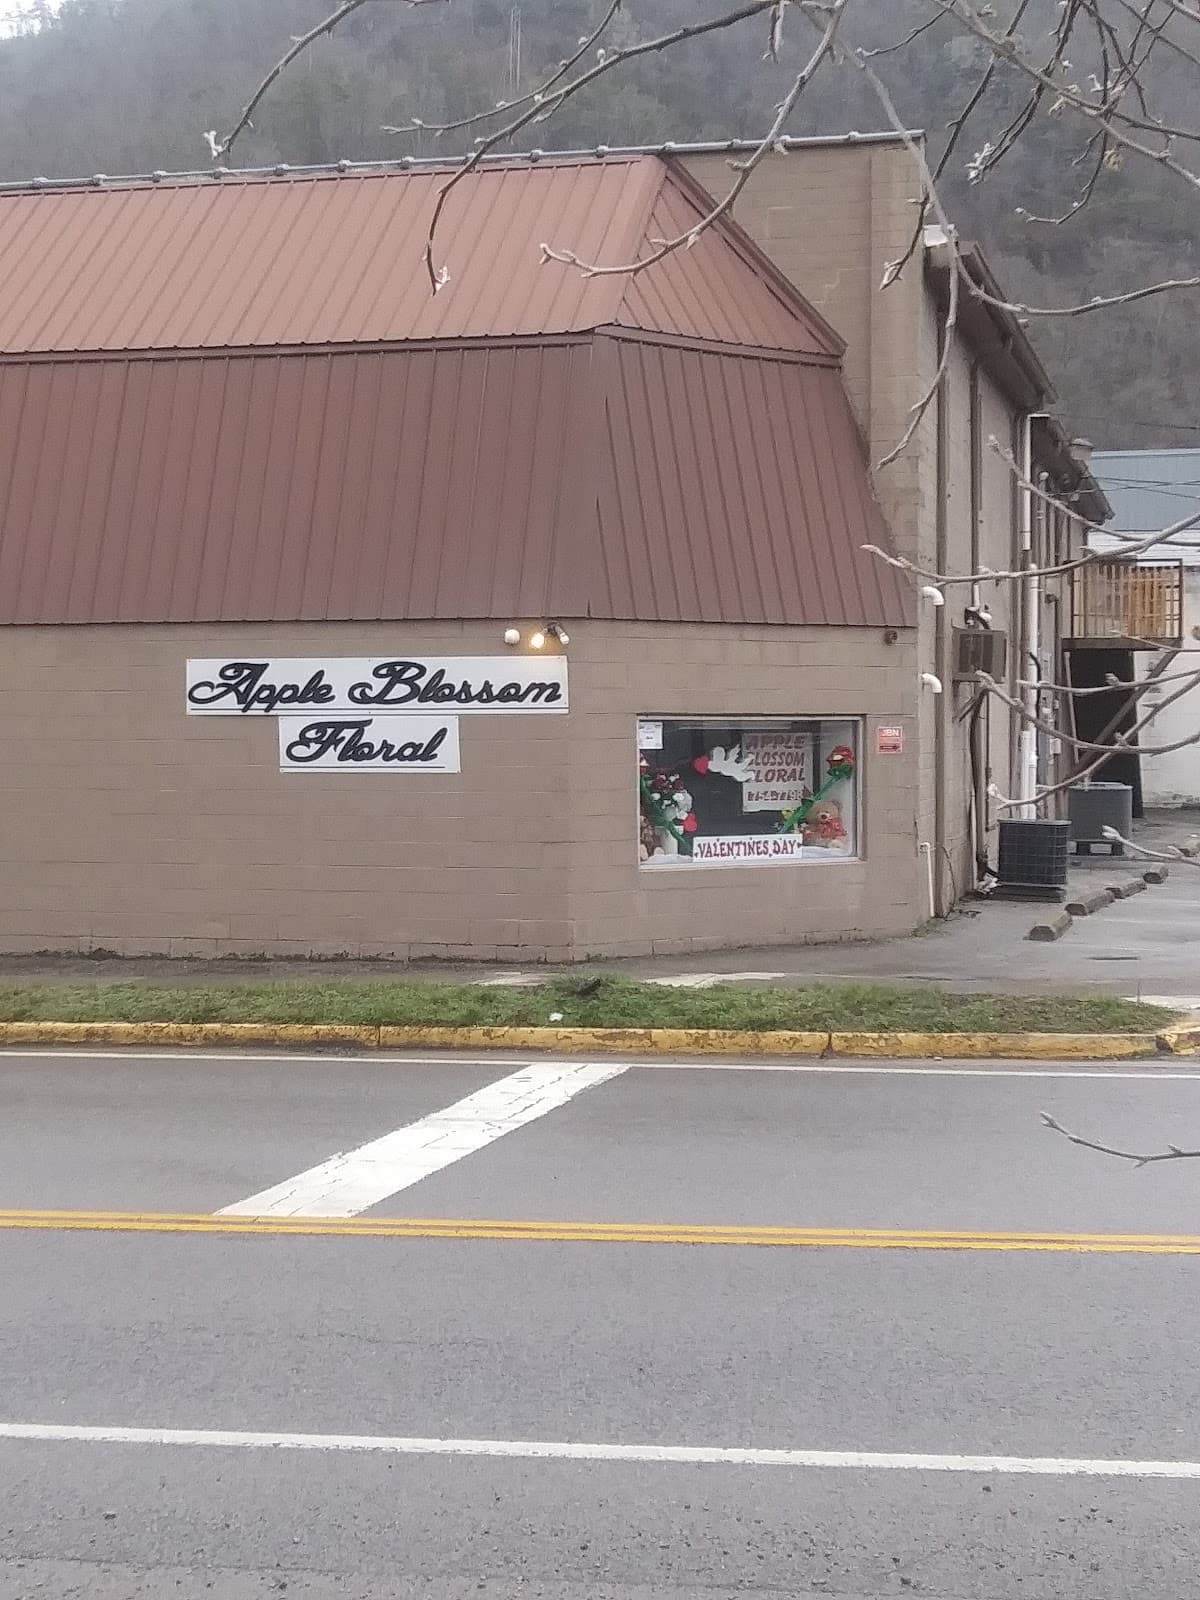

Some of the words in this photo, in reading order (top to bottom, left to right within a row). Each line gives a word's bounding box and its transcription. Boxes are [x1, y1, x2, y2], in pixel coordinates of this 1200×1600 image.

[188, 662, 336, 713] Apple
[348, 661, 562, 705] Blossom
[286, 719, 448, 763] Floral
[746, 735, 806, 750] APPLE
[748, 768, 806, 783] LORAL
